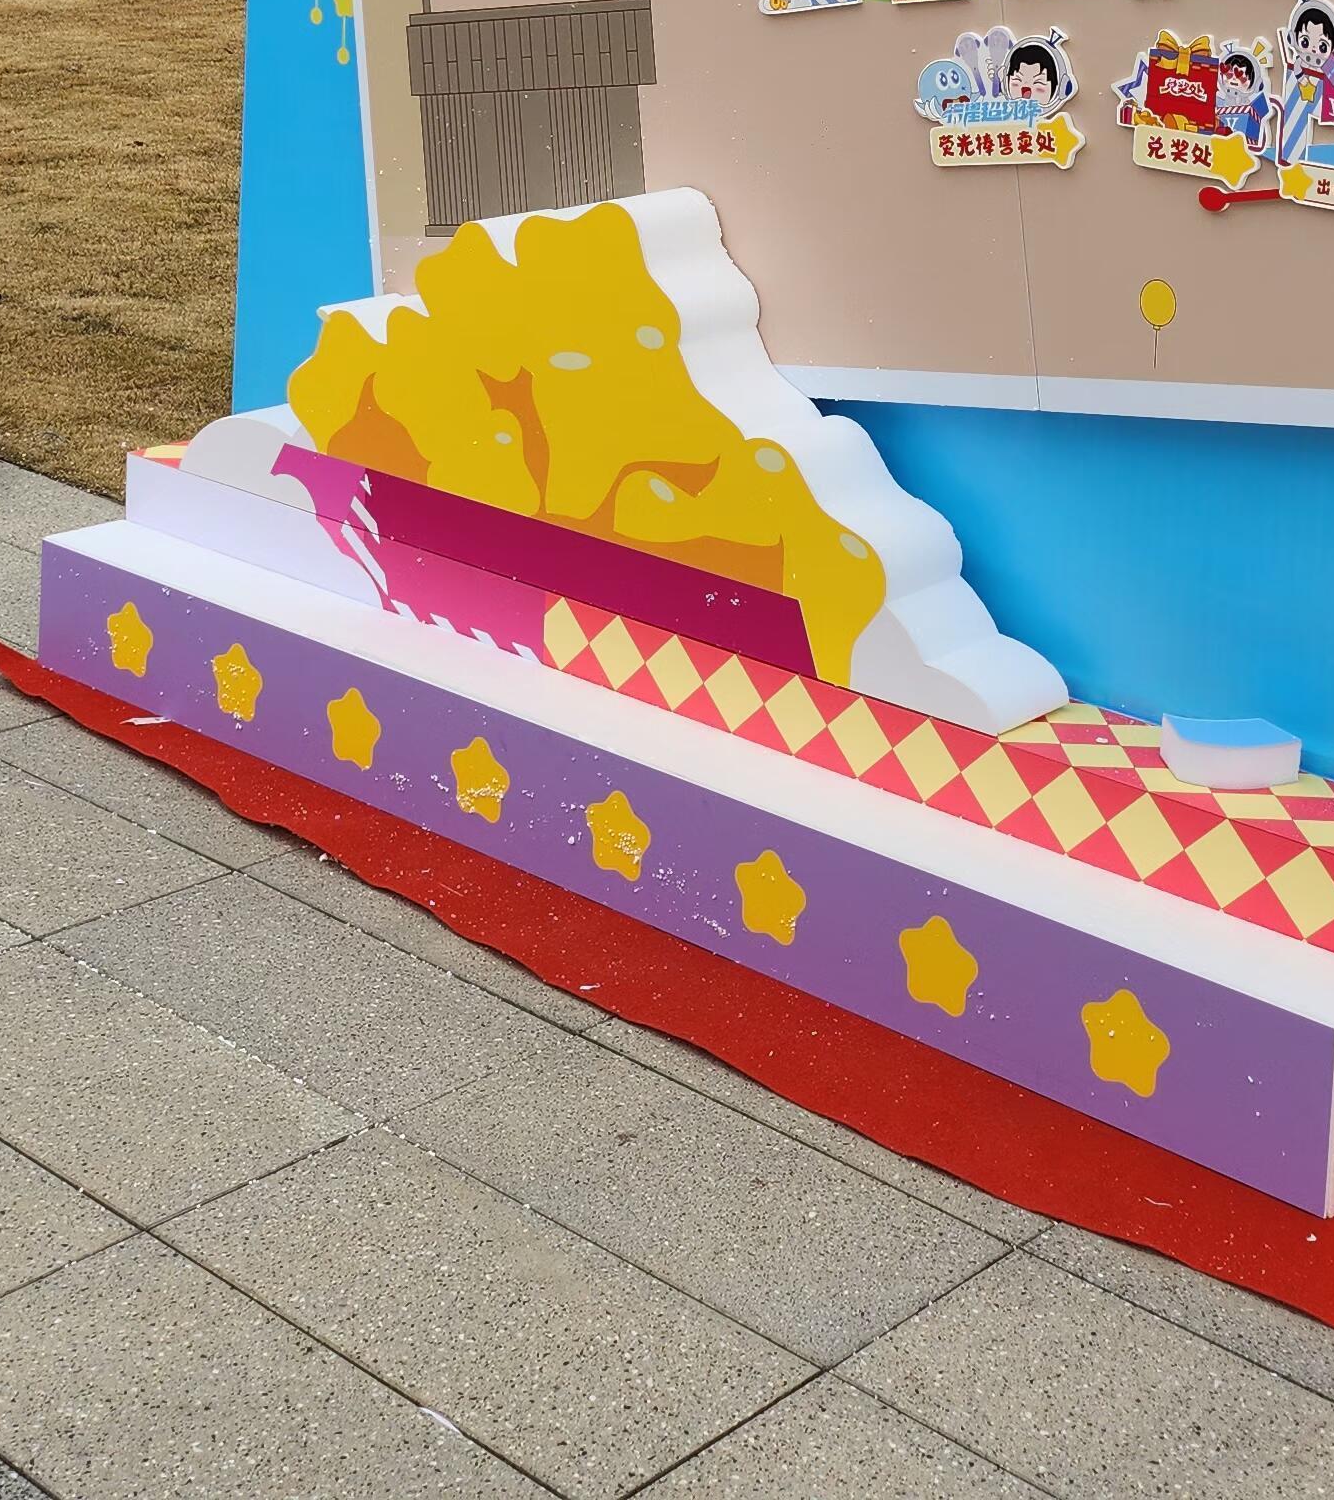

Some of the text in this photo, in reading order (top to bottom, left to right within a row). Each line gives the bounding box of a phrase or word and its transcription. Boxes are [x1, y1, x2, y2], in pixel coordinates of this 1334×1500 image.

[1165, 78, 1206, 99] 兑奖处
[938, 130, 1056, 157] 荧光棒售卖处
[1146, 135, 1213, 168] 兑奖处
